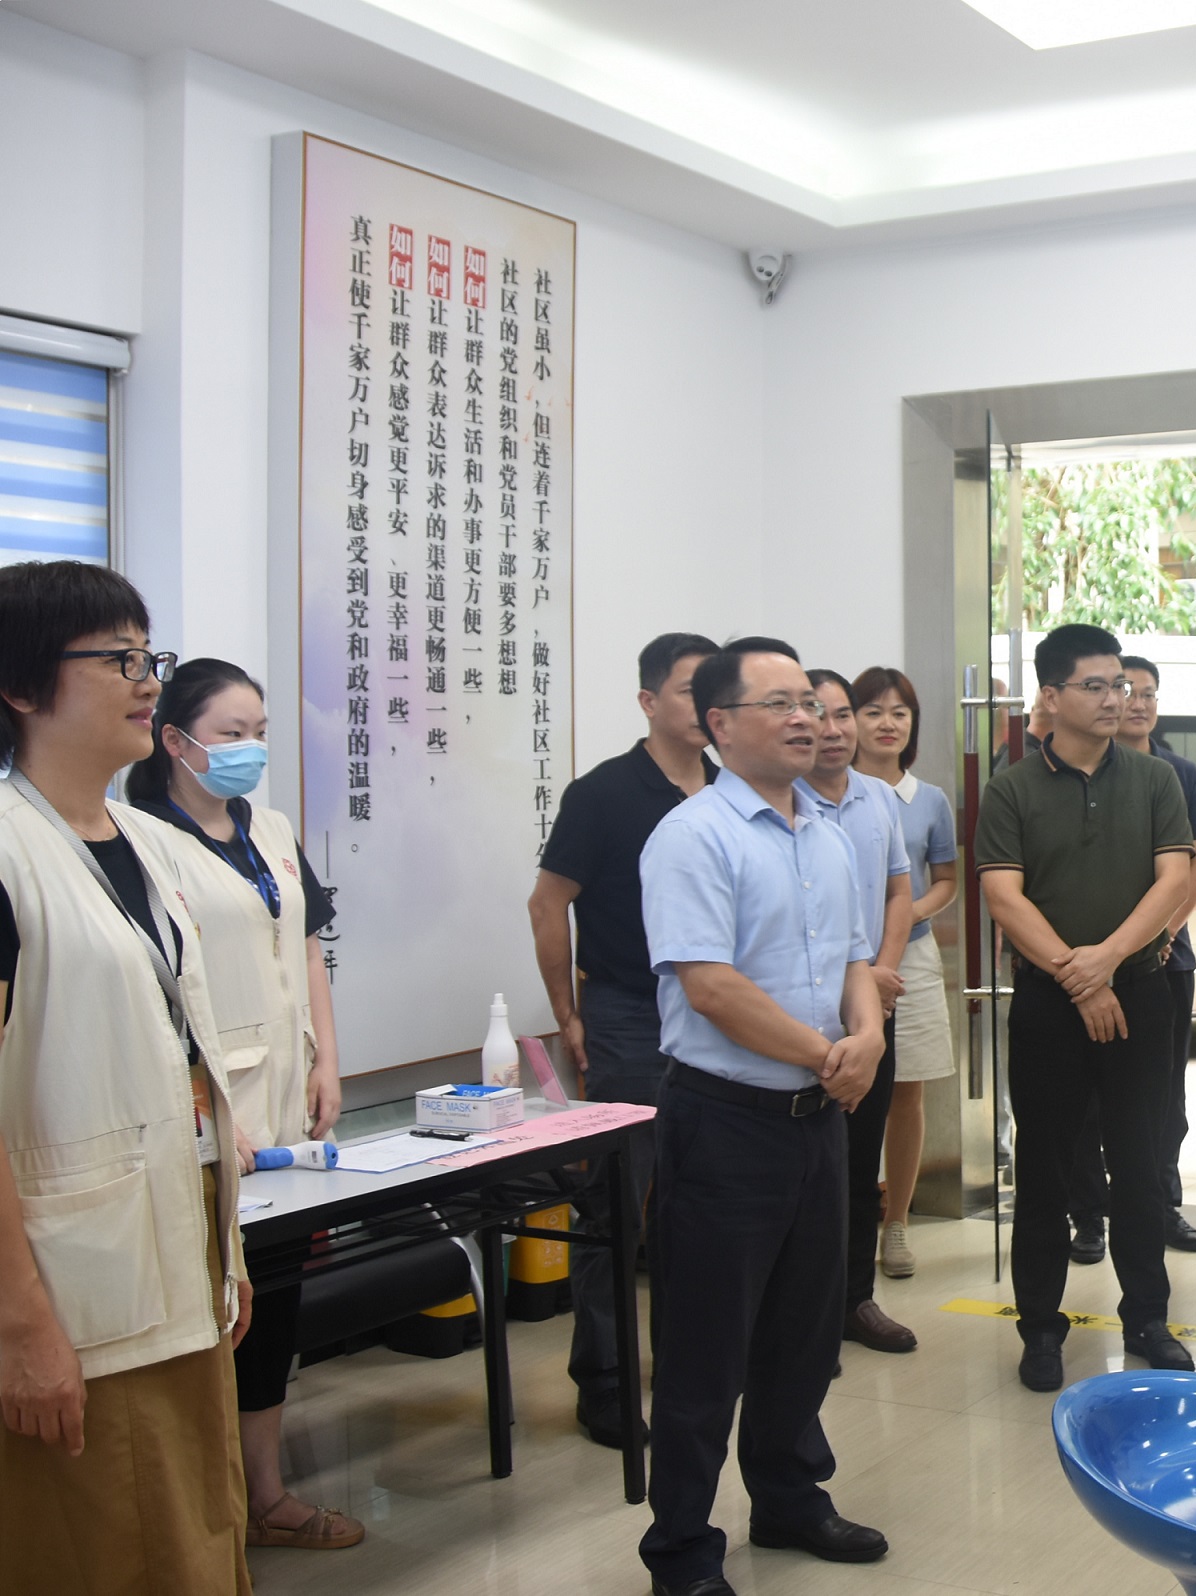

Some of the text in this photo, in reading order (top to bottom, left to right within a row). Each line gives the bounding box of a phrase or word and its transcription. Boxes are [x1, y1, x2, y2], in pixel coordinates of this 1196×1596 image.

[498, 257, 519, 696] 社区的党组织和党员干部要多想想
[421, 1100, 471, 1112] FACE MASK
